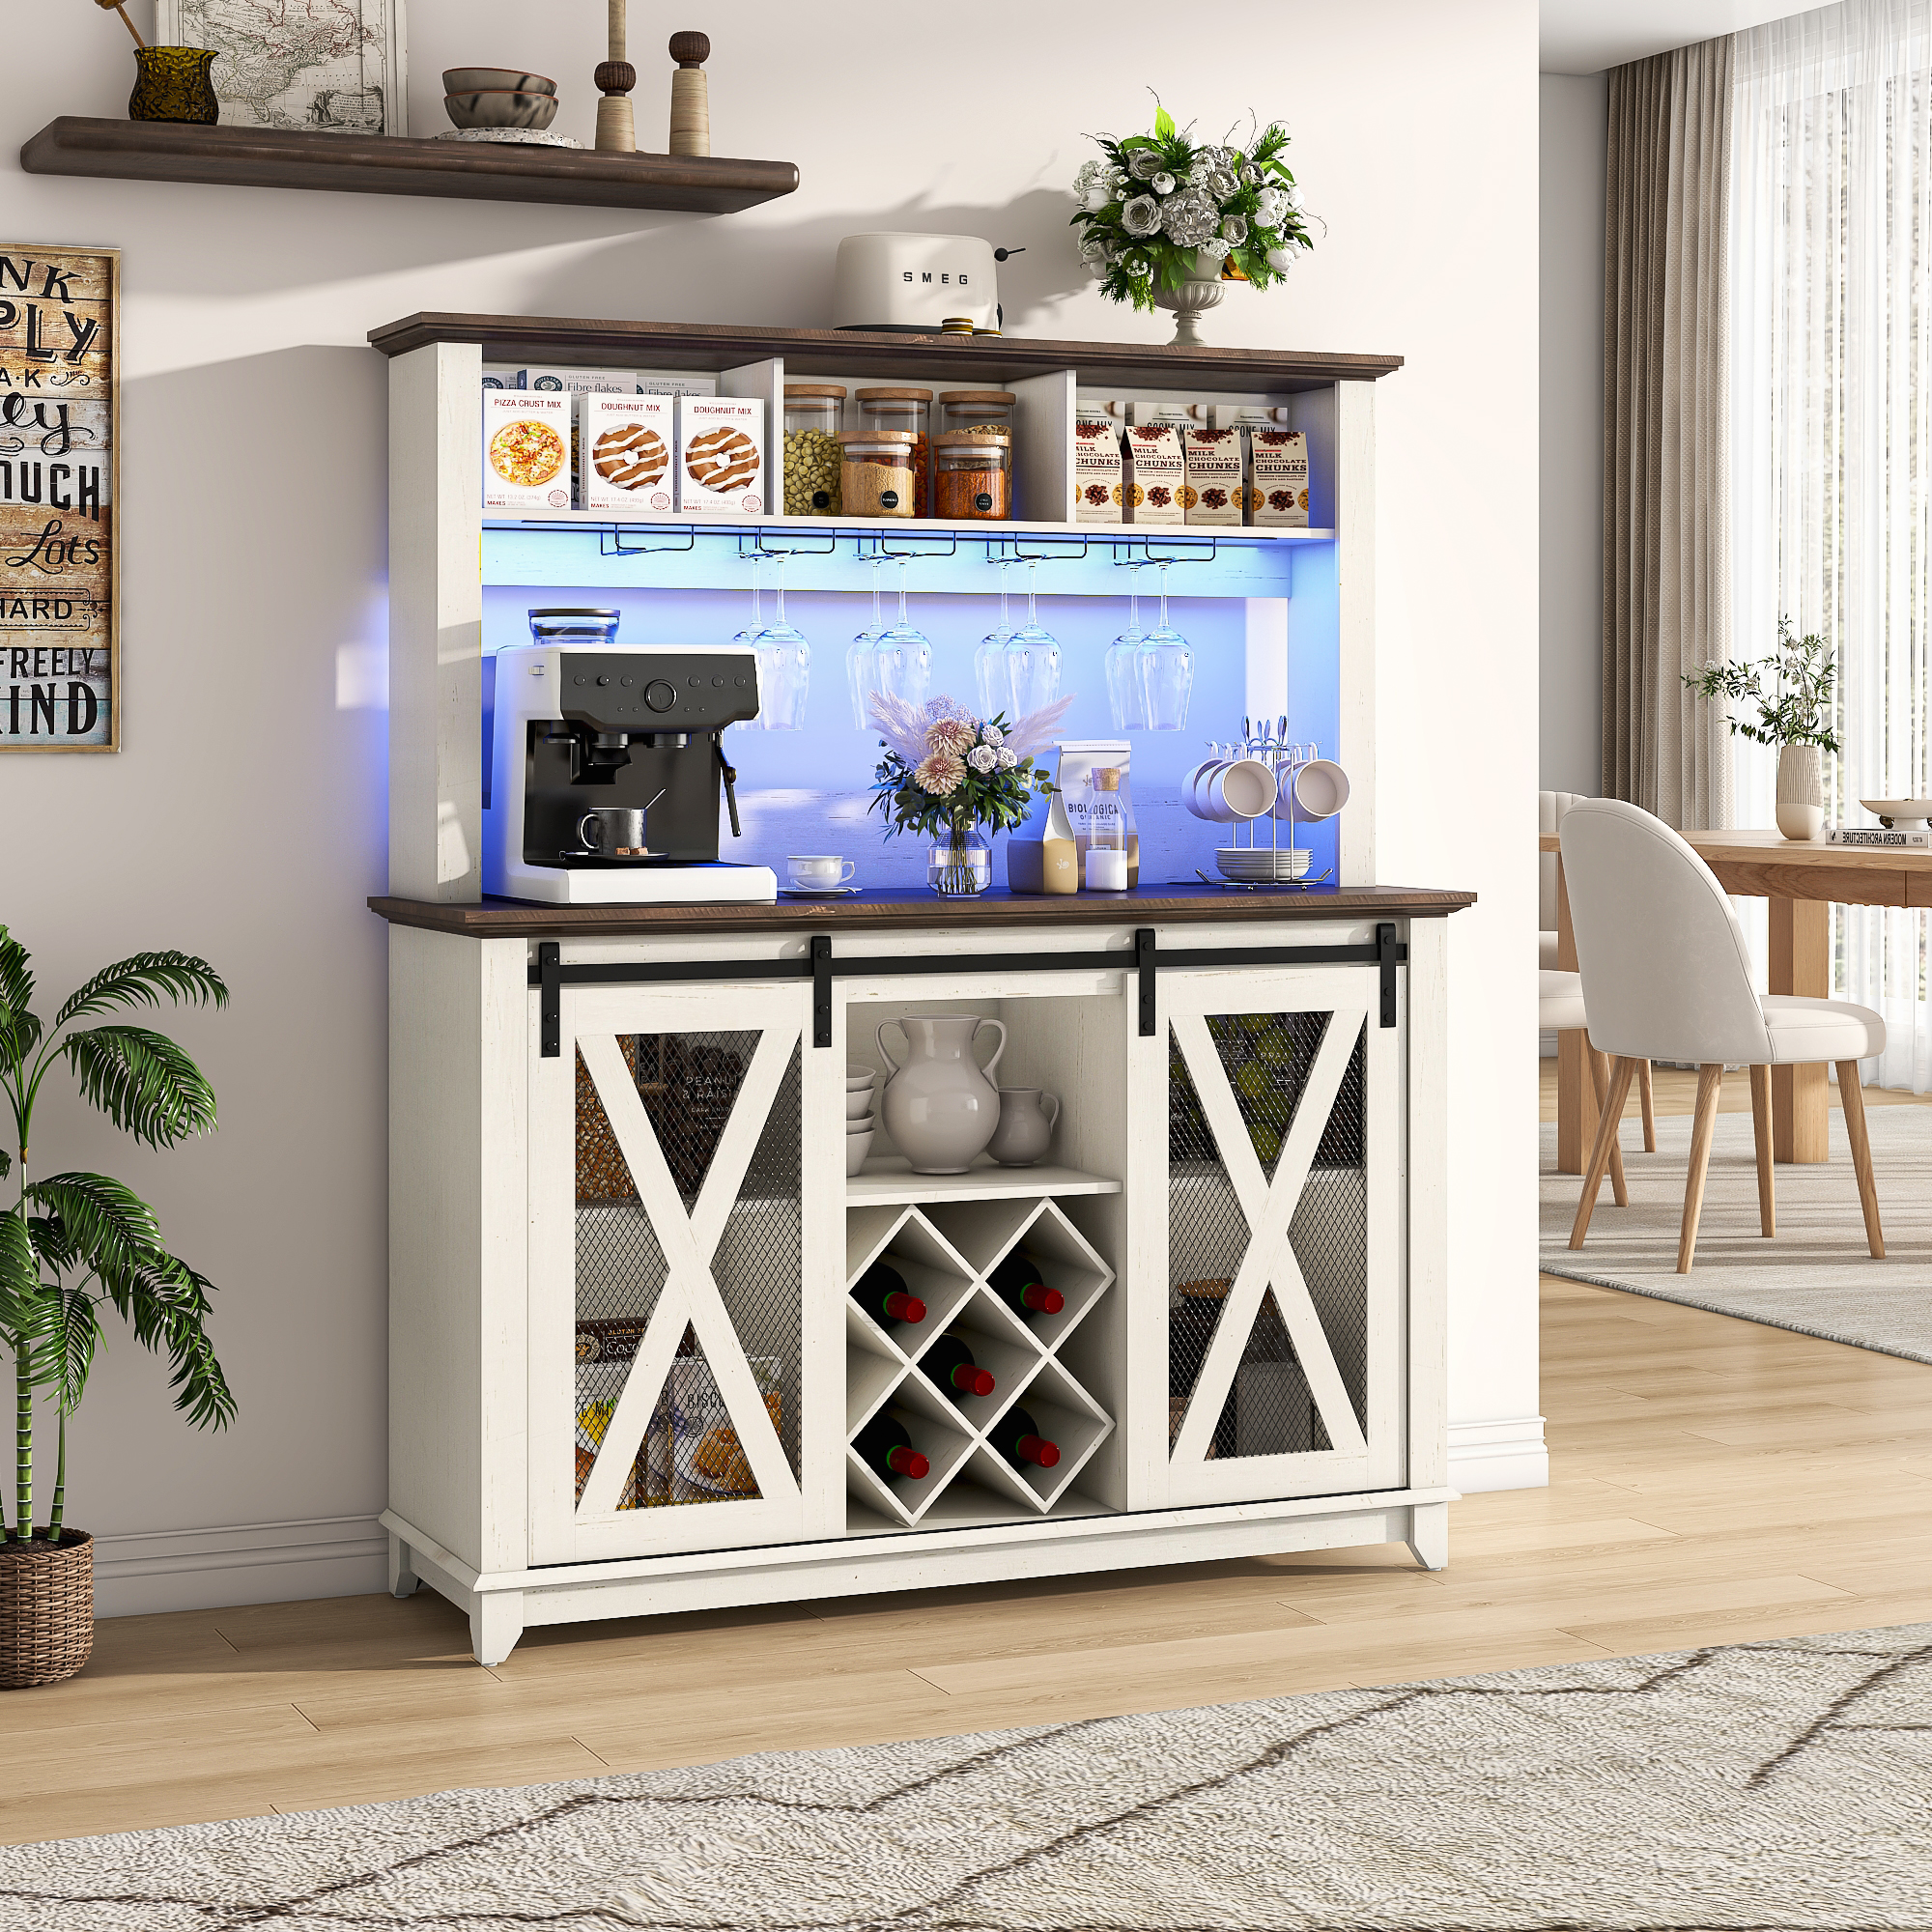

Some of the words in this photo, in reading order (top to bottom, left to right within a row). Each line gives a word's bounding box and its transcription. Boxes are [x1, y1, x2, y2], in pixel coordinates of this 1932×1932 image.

[903, 271, 968, 285] SMEG
[567, 383, 592, 392] Fibre
[594, 383, 623, 393] flakes
[494, 398, 517, 407] PIZZA
[519, 399, 545, 408] CRUST
[547, 400, 561, 409] MIX
[601, 402, 643, 412] DOUGHNUT
[646, 404, 661, 412] MIX
[694, 406, 735, 414] DOUGHNUT
[1135, 459, 1182, 468] CHUNKS
[5, 519, 100, 575] Lots
[0, 681, 98, 735] IND
